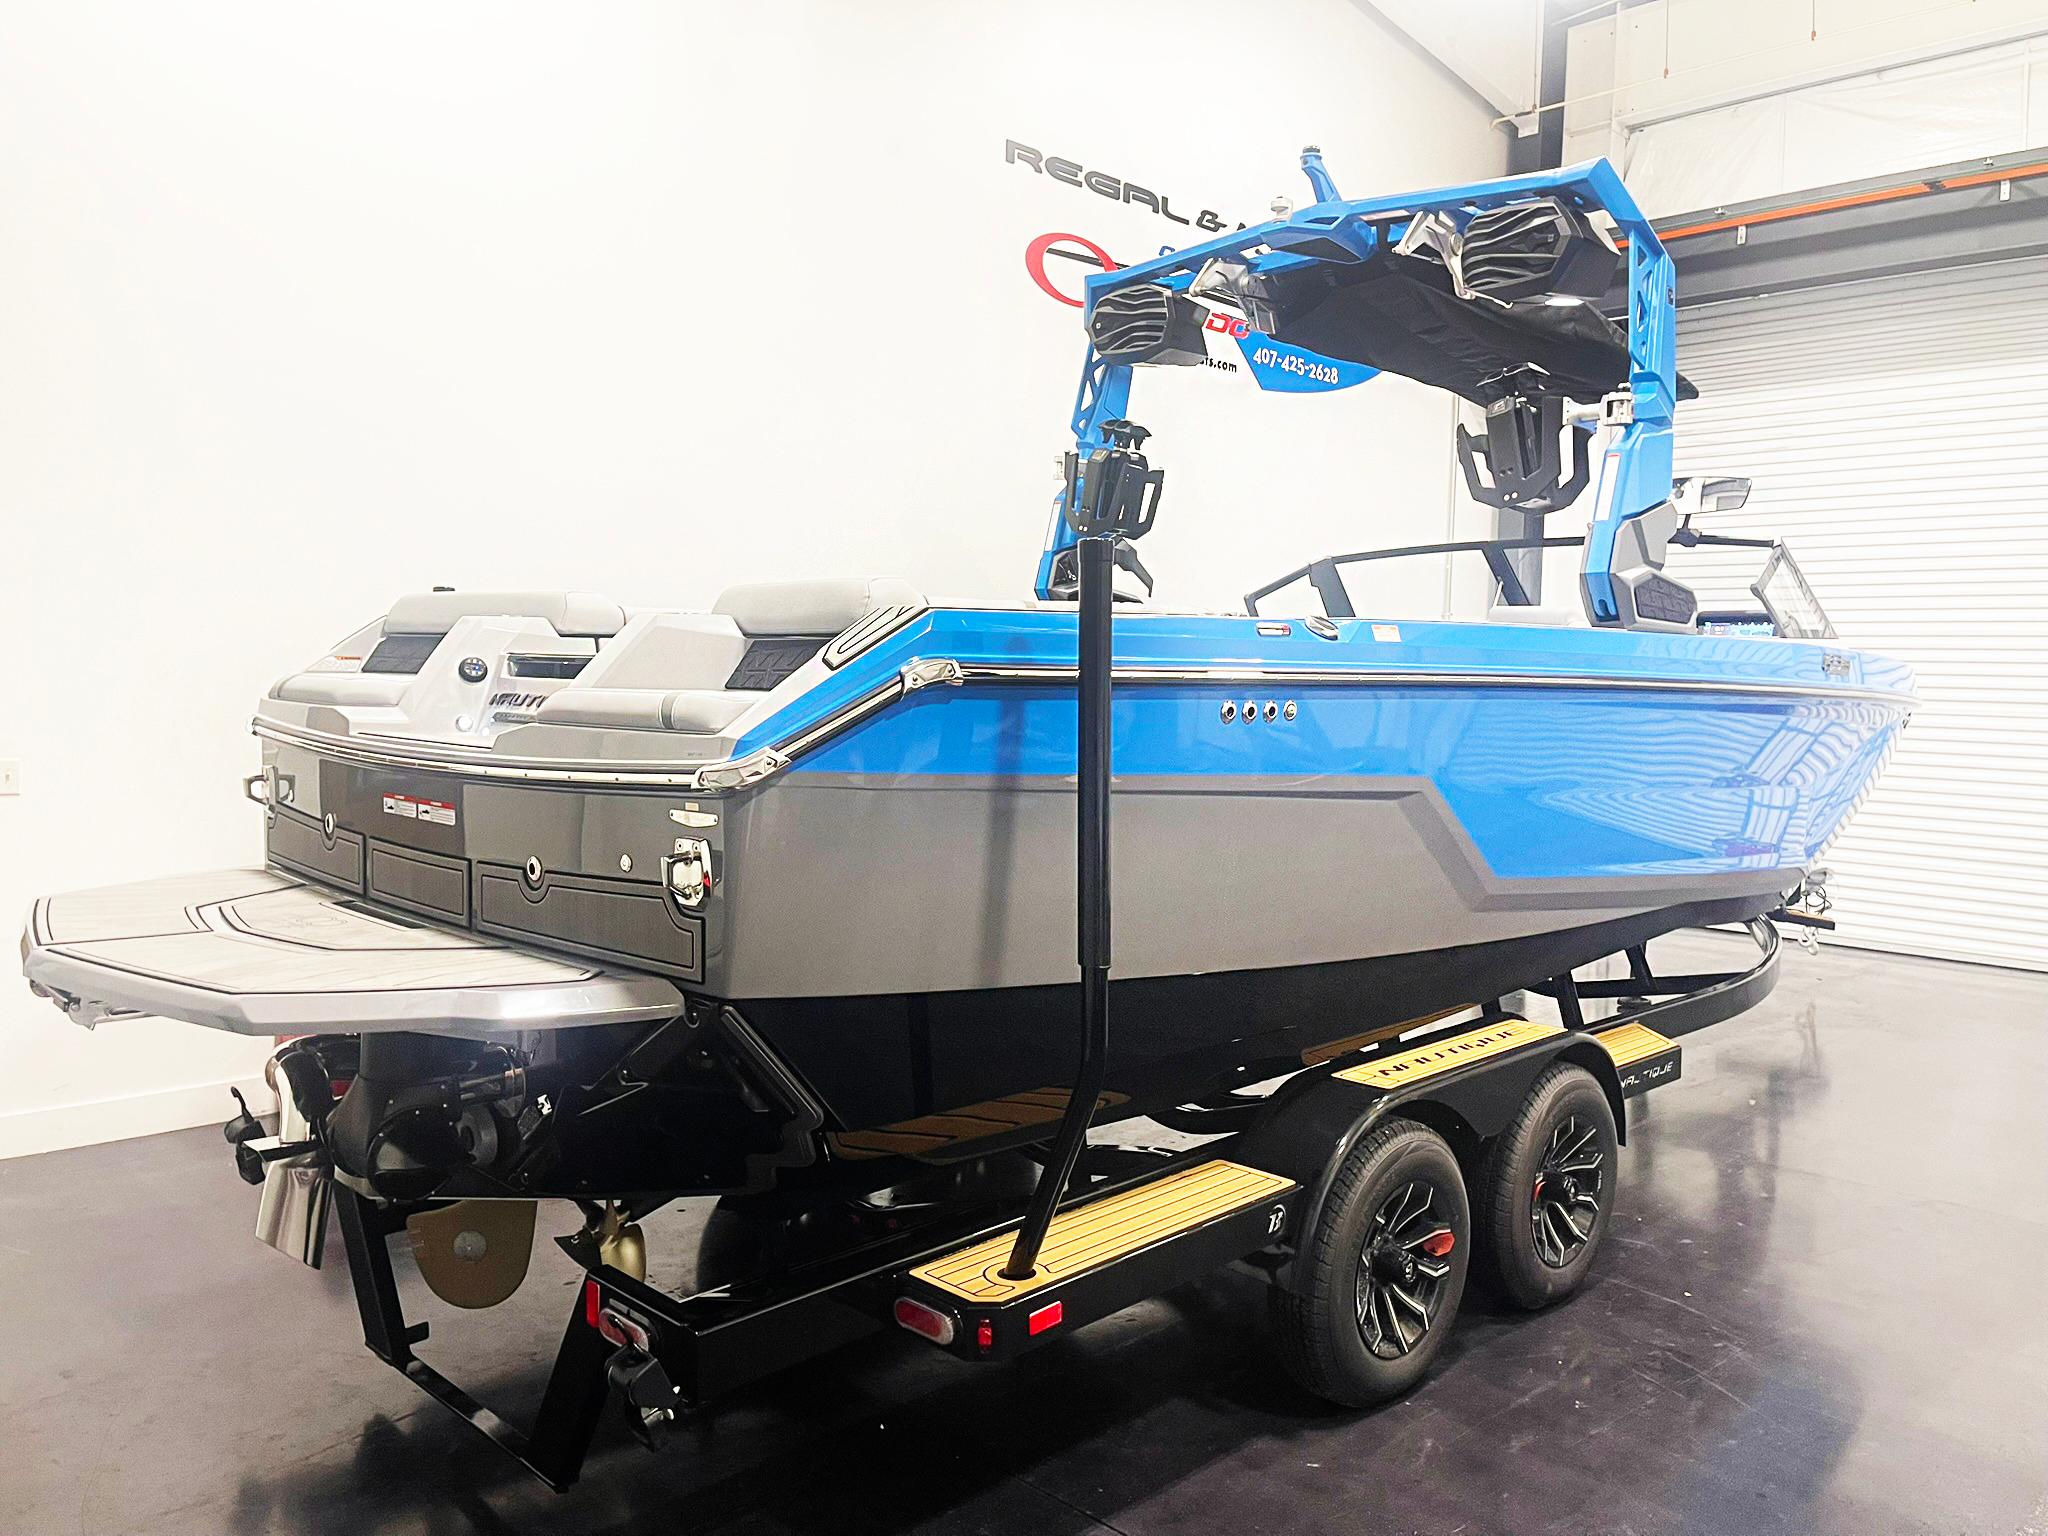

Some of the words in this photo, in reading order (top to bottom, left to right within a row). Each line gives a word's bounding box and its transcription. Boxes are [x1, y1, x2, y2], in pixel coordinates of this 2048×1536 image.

[1005, 138, 1190, 226] REGAL
[1195, 210, 1228, 233] &
[1252, 347, 1339, 385] 407-425-2628
